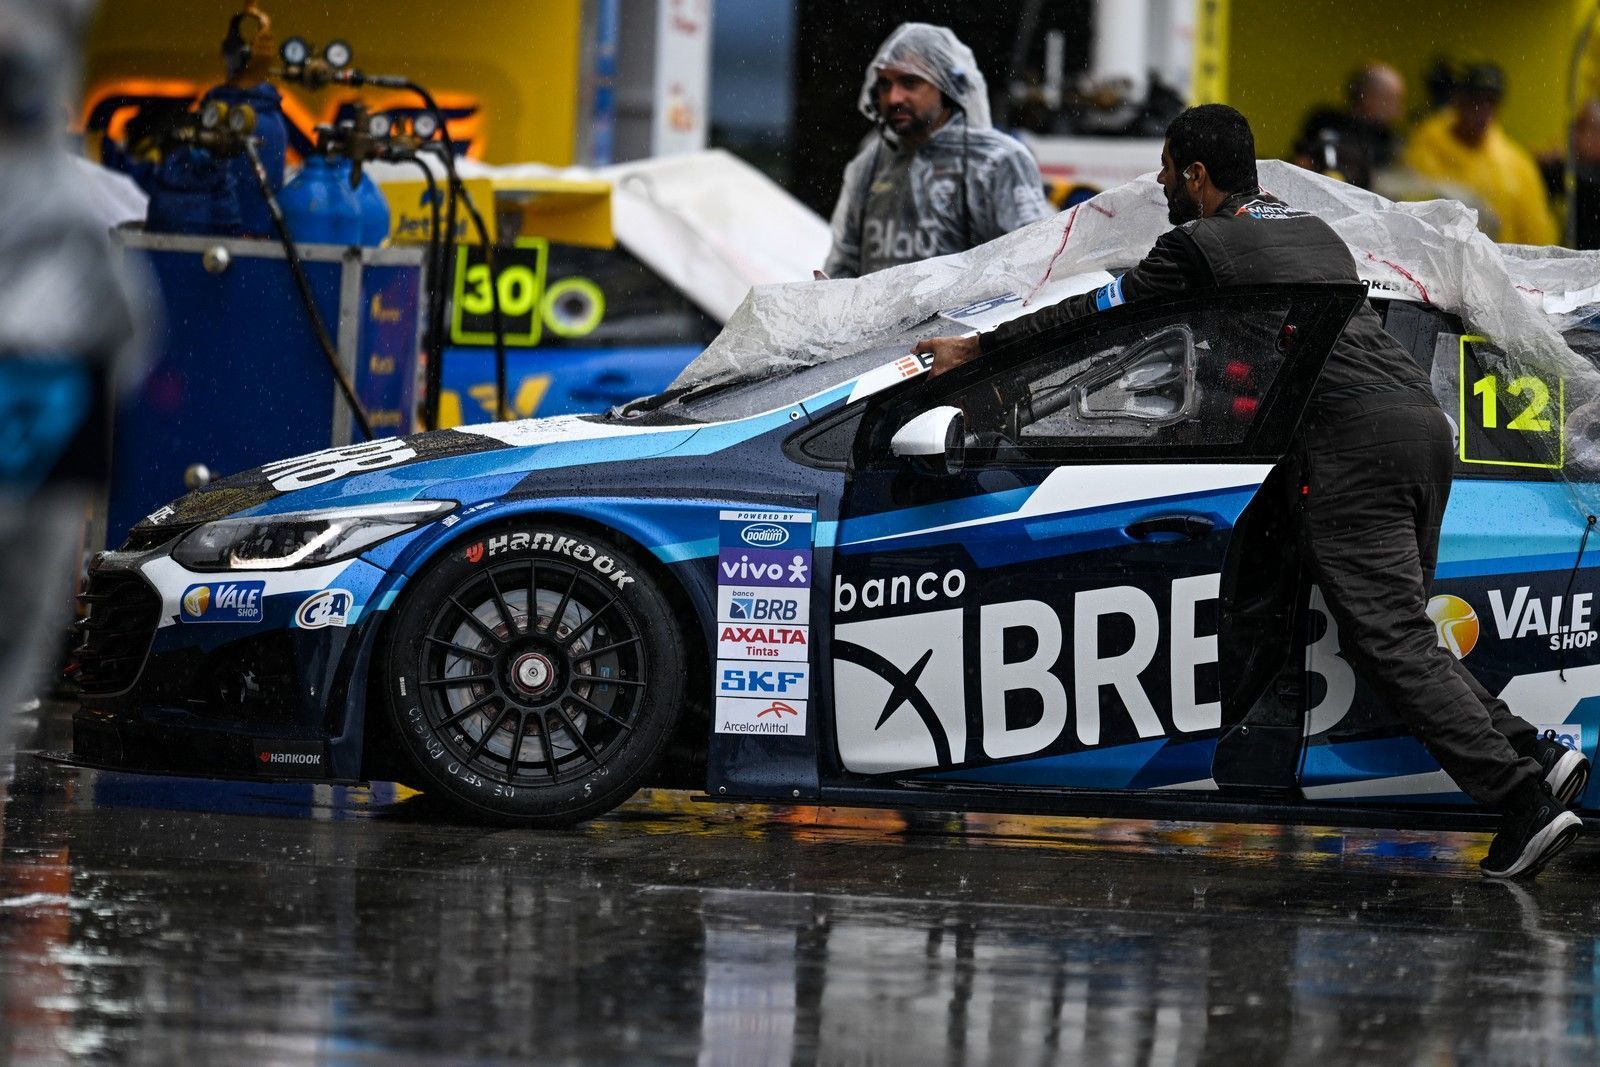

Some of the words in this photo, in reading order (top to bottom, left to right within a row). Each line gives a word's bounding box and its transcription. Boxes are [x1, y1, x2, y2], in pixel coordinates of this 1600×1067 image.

[462, 264, 536, 317] 30
[1473, 374, 1552, 432] 12
[747, 529, 783, 541] podium
[722, 555, 783, 580] vivo
[215, 585, 260, 609] VALE
[834, 568, 966, 614] banco
[238, 609, 259, 618] SHOP
[304, 593, 346, 624] CBA
[753, 599, 798, 620] BRB
[1487, 586, 1593, 640] VALE
[720, 627, 807, 644] AXALTA
[1550, 630, 1599, 651] SHOP
[746, 646, 780, 657] Tintas
[721, 670, 805, 692] SKF
[723, 721, 789, 734] ArcelorMittal
